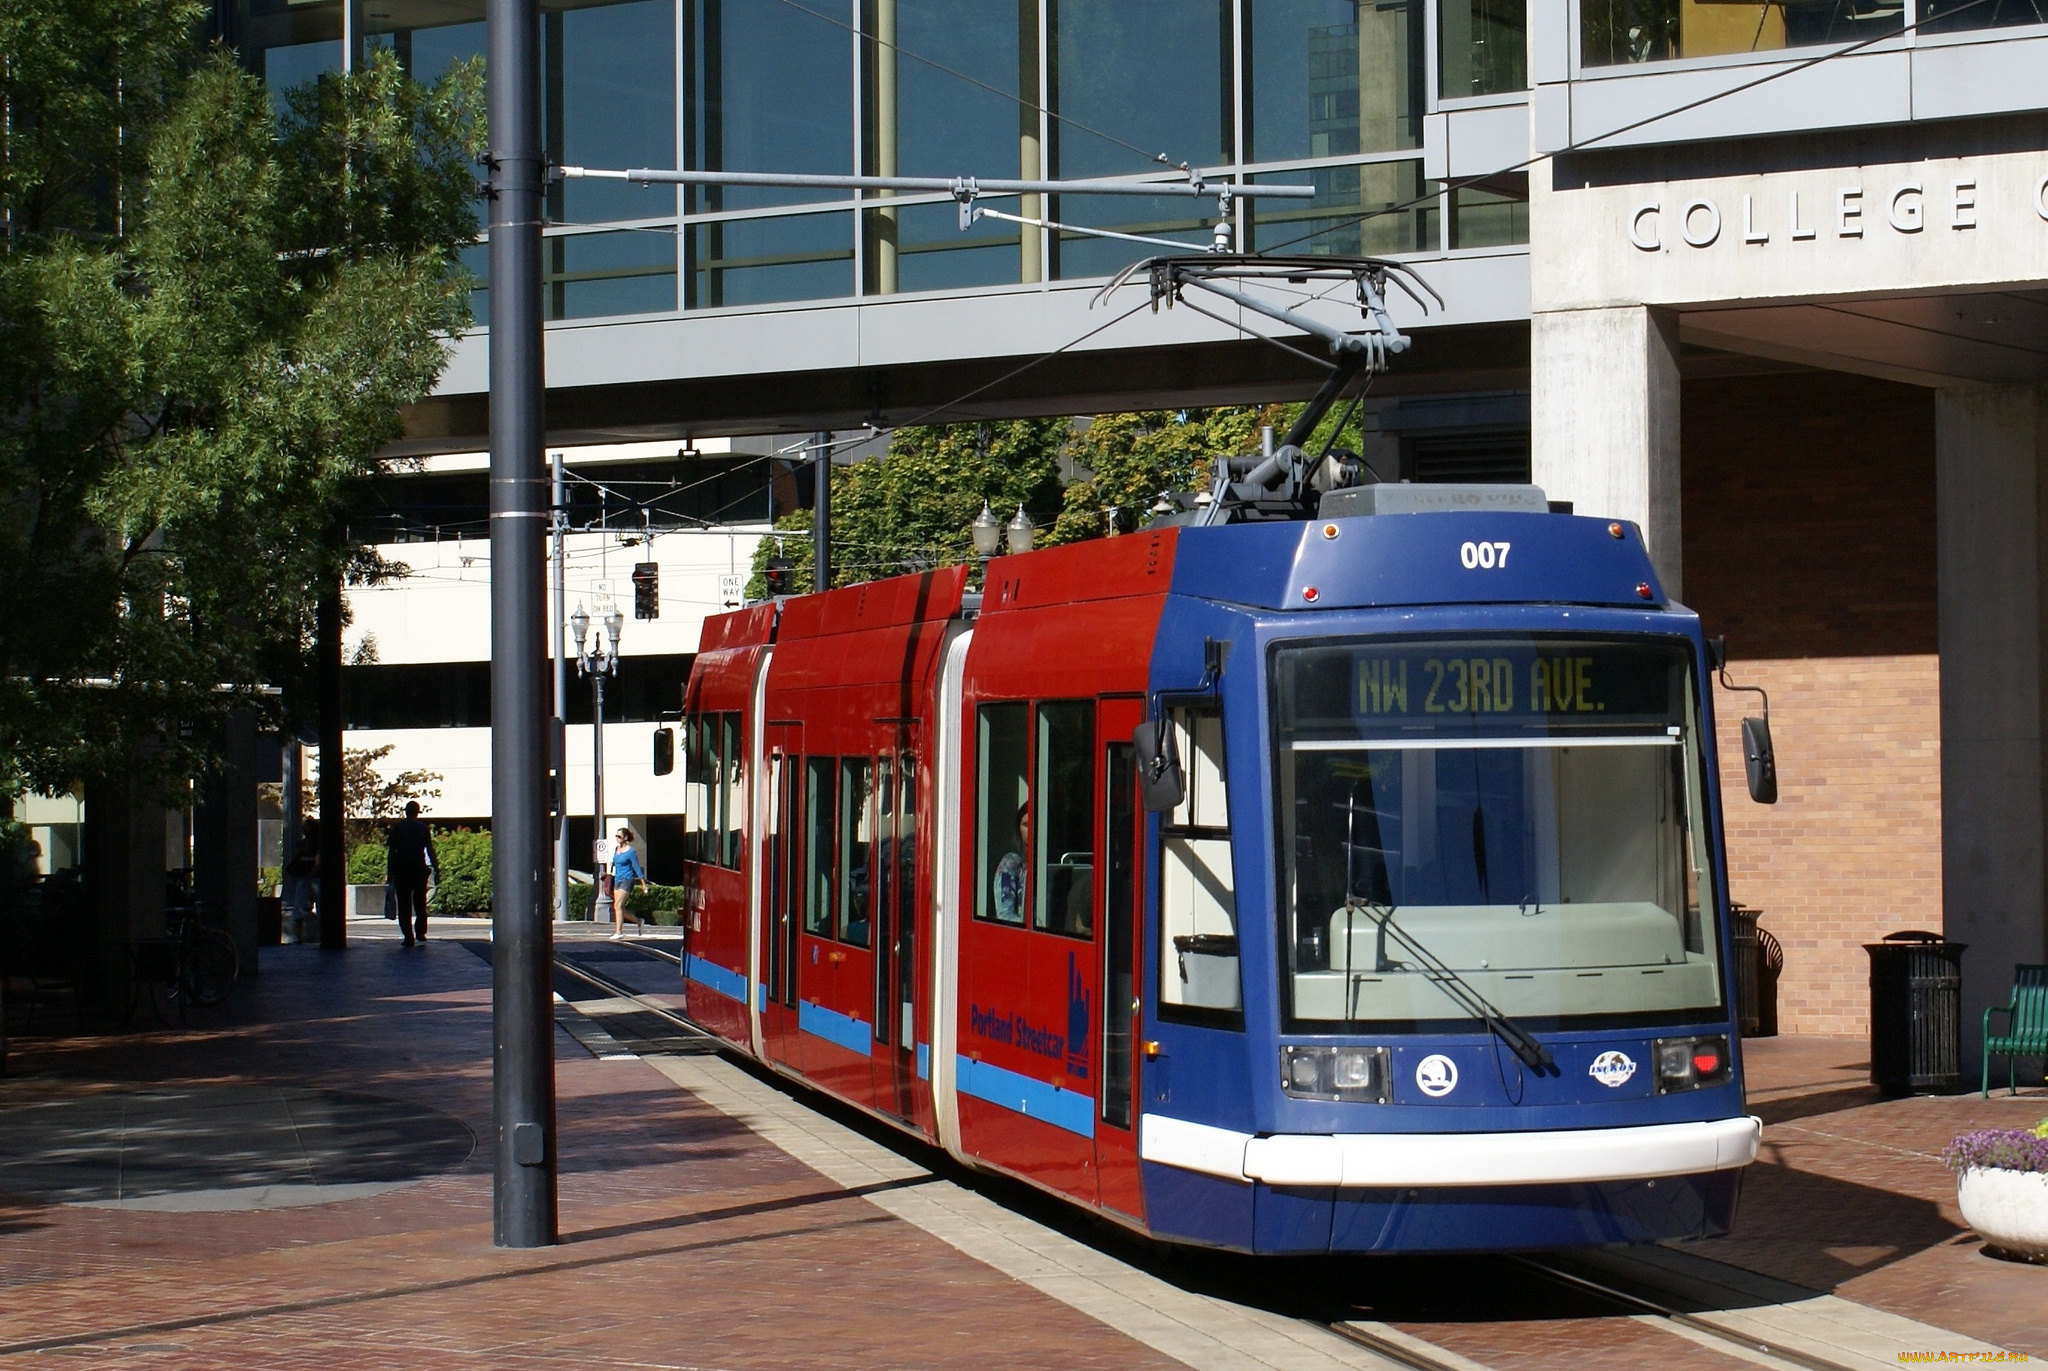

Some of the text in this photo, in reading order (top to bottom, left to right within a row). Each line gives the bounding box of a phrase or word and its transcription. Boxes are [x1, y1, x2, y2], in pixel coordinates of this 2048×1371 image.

[1627, 178, 1976, 251] COLLEGE
[1461, 542, 1510, 569] 007
[723, 578, 739, 586] ONE
[723, 588, 739, 596] WAY
[1359, 657, 1604, 712] NW 23RD AVE.
[971, 1003, 1063, 1059] Portland Streetcar
